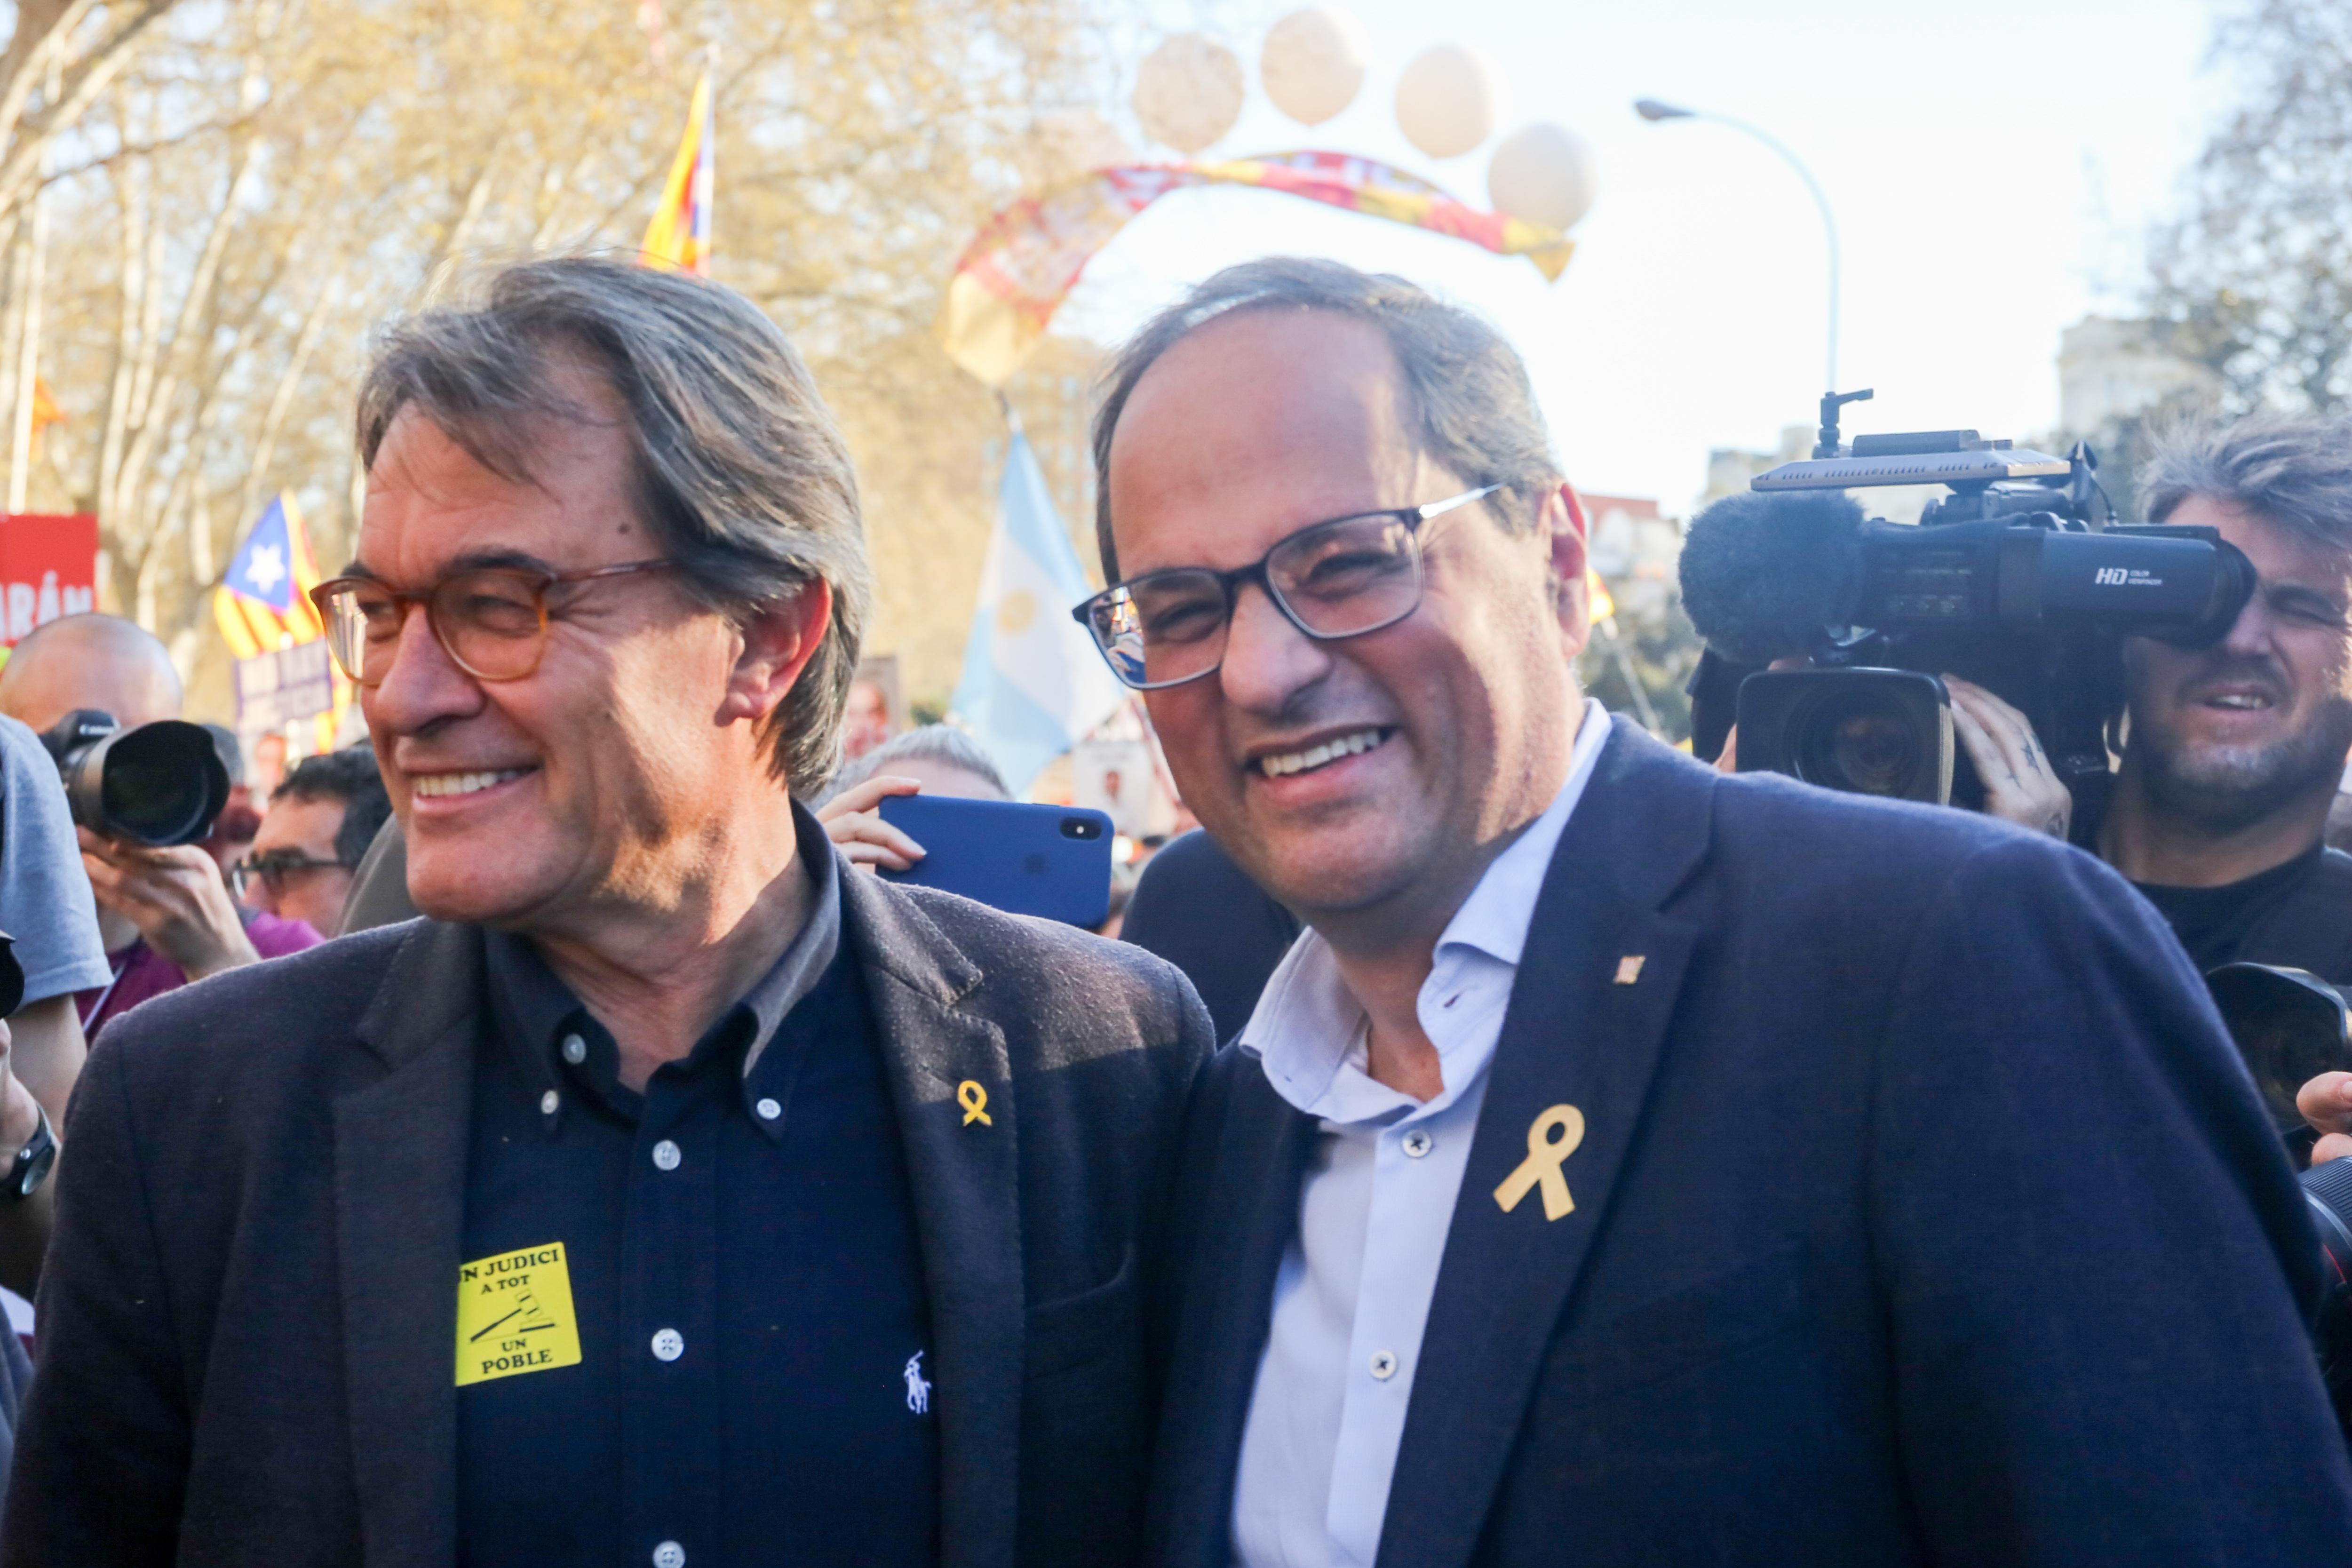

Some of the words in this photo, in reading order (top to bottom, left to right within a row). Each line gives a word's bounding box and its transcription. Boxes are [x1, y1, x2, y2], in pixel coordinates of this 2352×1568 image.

[2095, 567, 2128, 585] HD
[485, 1250, 558, 1276] JUDICI
[481, 1284, 493, 1295] A
[497, 1275, 529, 1289] TOT
[502, 1339, 526, 1352] UN
[482, 1349, 553, 1374] POBLE
